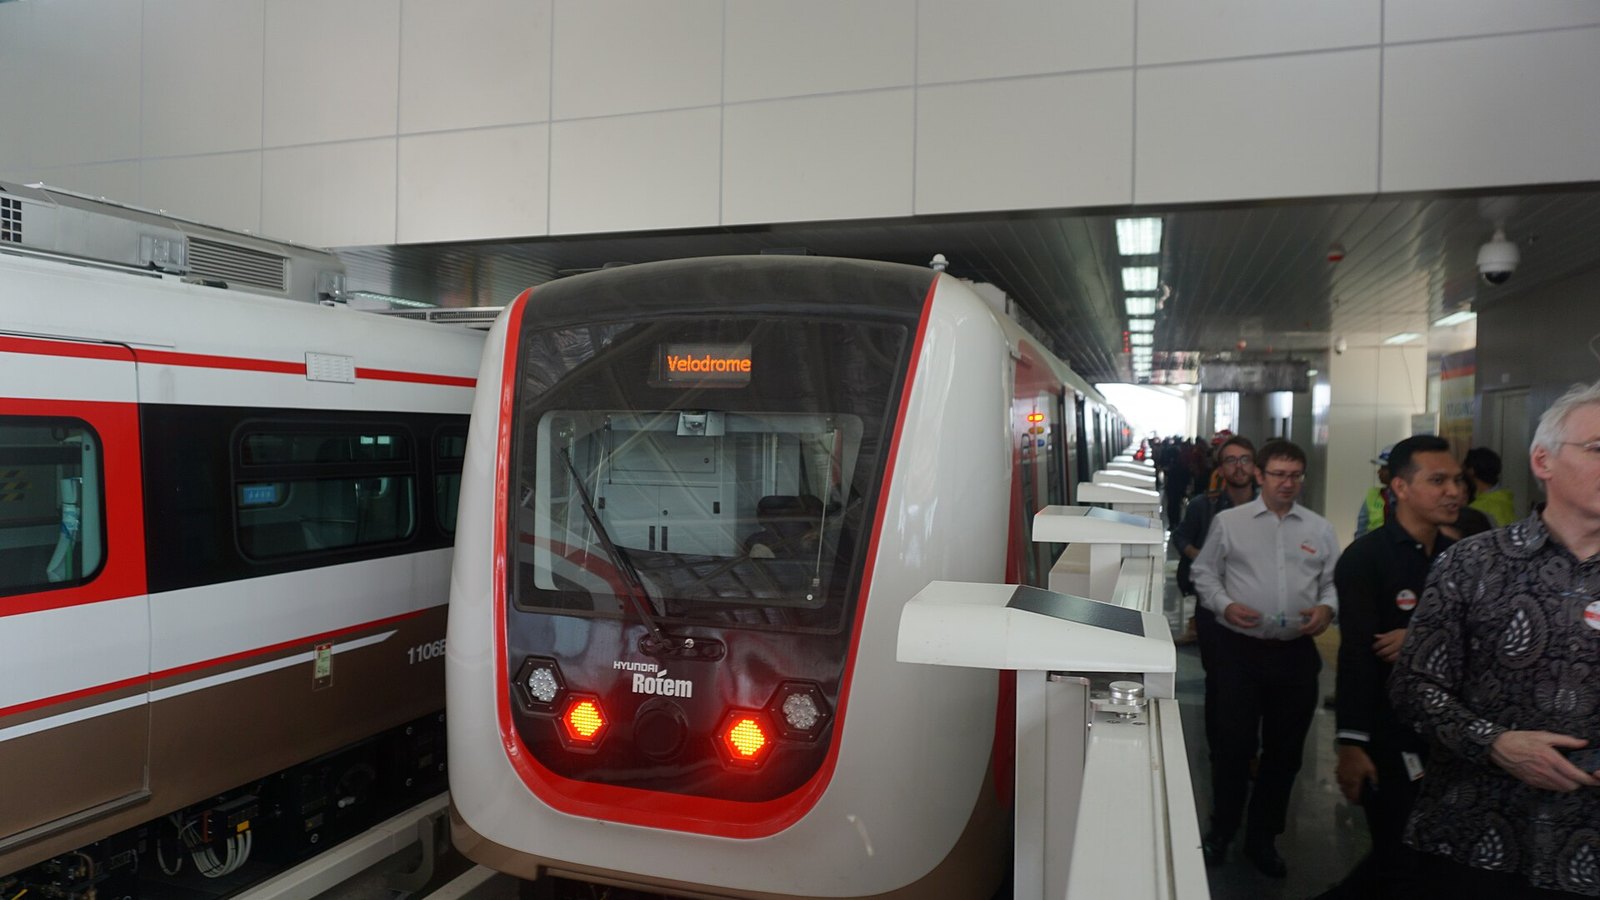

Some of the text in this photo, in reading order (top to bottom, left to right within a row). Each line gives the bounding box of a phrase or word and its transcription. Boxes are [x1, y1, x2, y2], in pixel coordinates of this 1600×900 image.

[667, 355, 752, 372] Velodrome
[613, 661, 658, 672] HYUNDAI
[632, 669, 693, 697] Rotem
